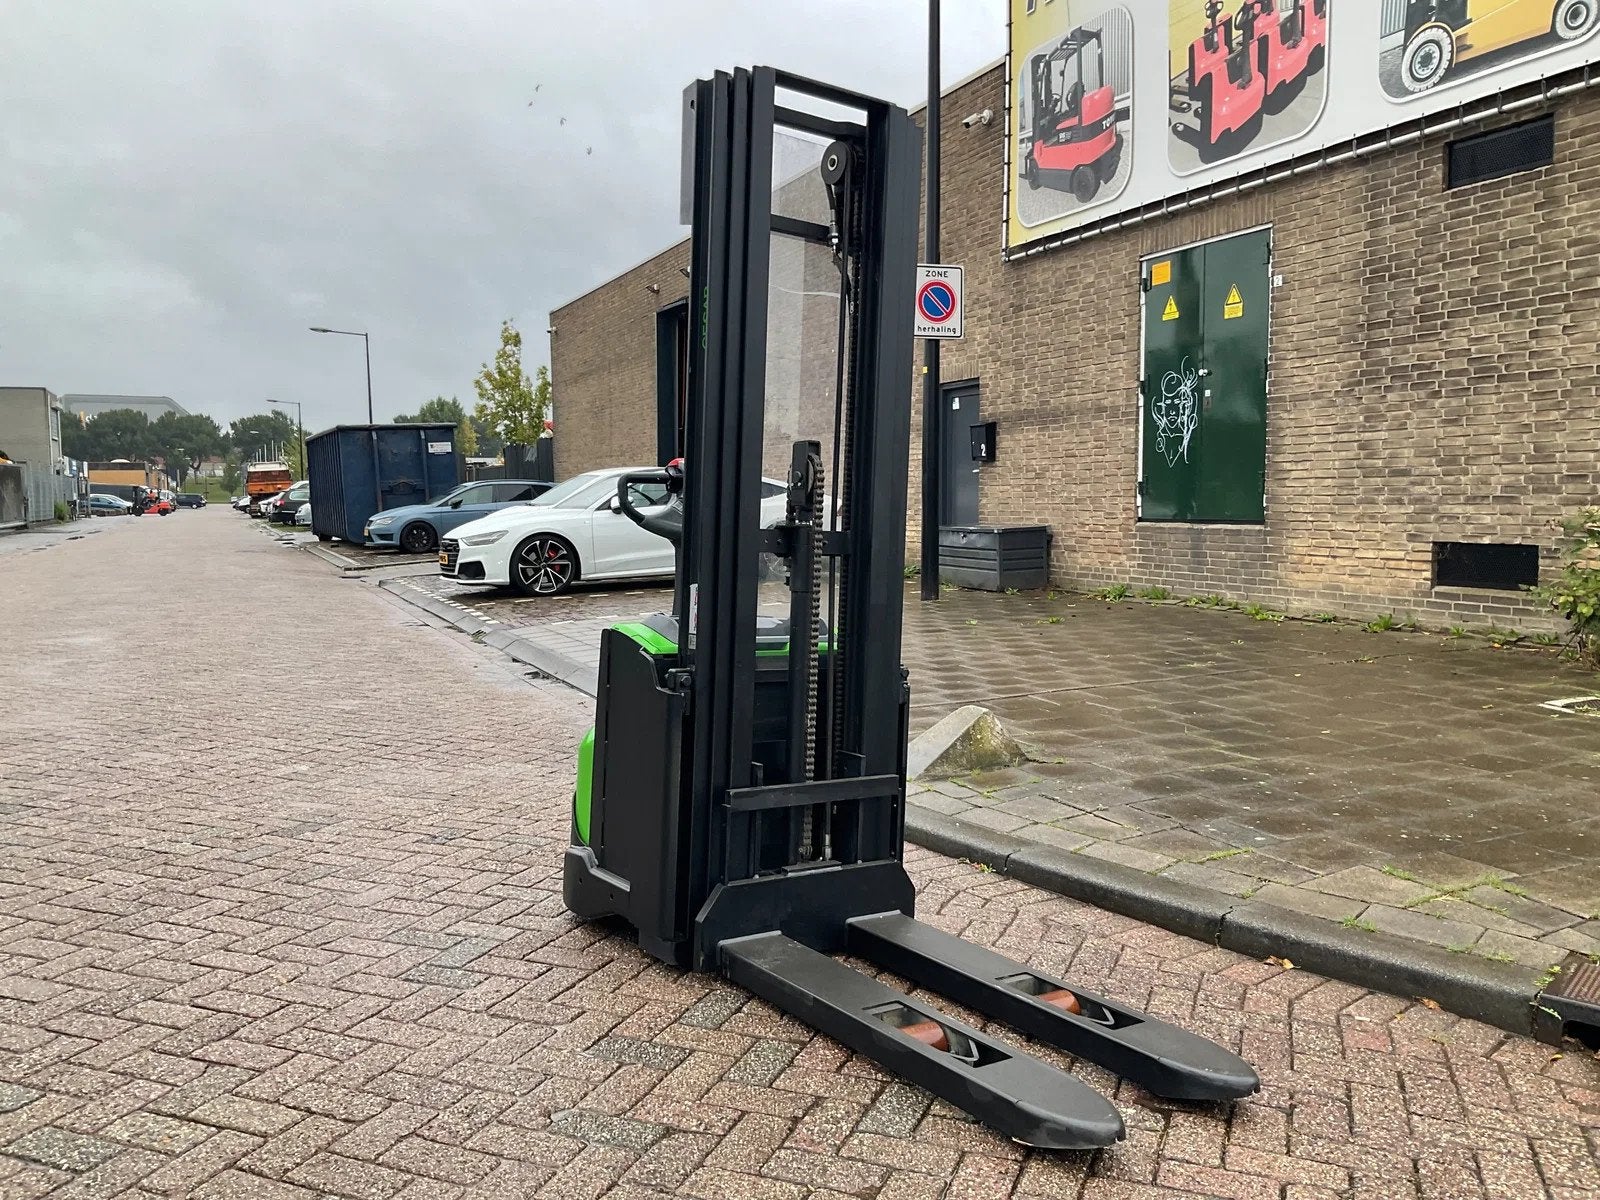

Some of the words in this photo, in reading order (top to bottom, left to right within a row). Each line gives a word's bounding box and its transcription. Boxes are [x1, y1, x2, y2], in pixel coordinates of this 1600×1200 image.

[925, 270, 949, 278] ZONE
[917, 325, 957, 335] herhaling
[980, 443, 987, 457] 2
